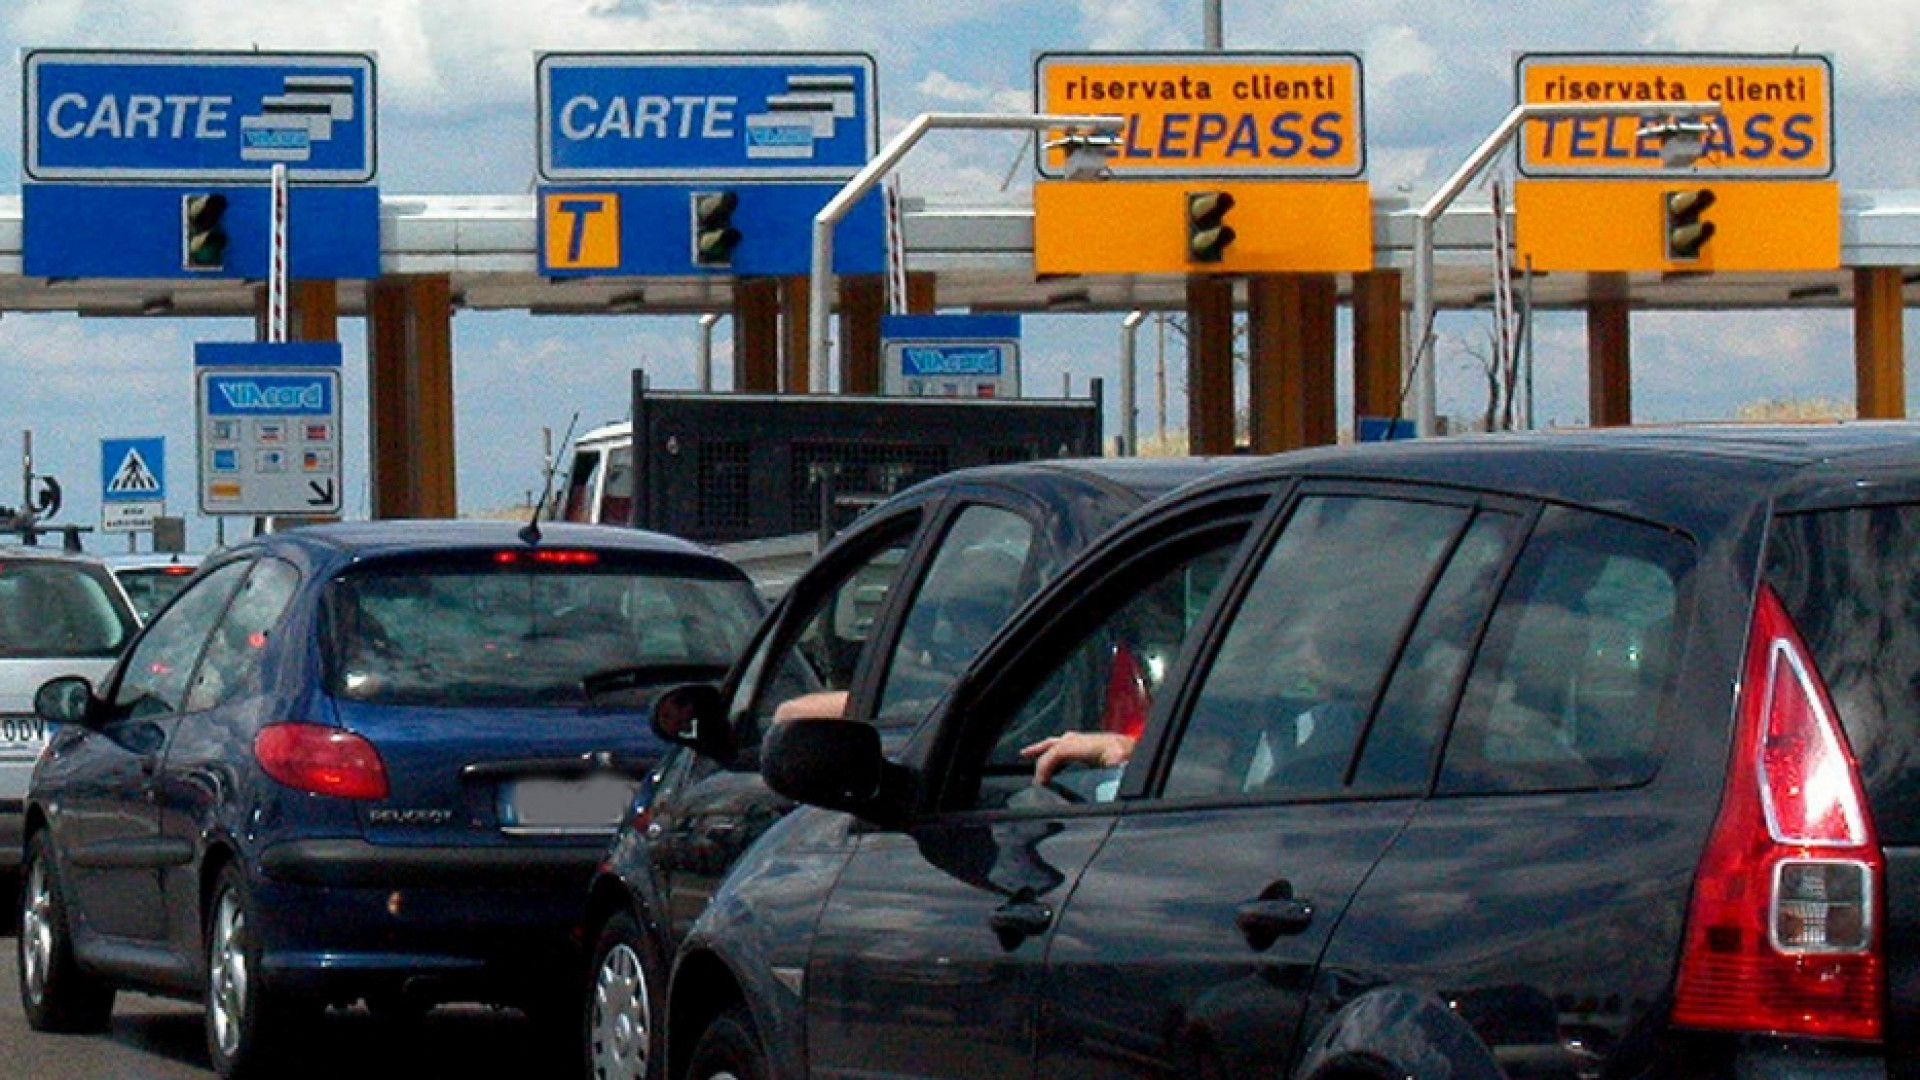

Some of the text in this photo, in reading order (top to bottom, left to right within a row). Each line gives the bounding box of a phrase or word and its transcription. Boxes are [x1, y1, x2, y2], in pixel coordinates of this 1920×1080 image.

[1066, 76, 1334, 100] riservata clienti
[1545, 76, 1806, 101] riservata clienti
[47, 93, 232, 138] CARTE
[560, 95, 738, 140] CARTE
[1066, 112, 1343, 159] LEPASS
[558, 201, 604, 262] T
